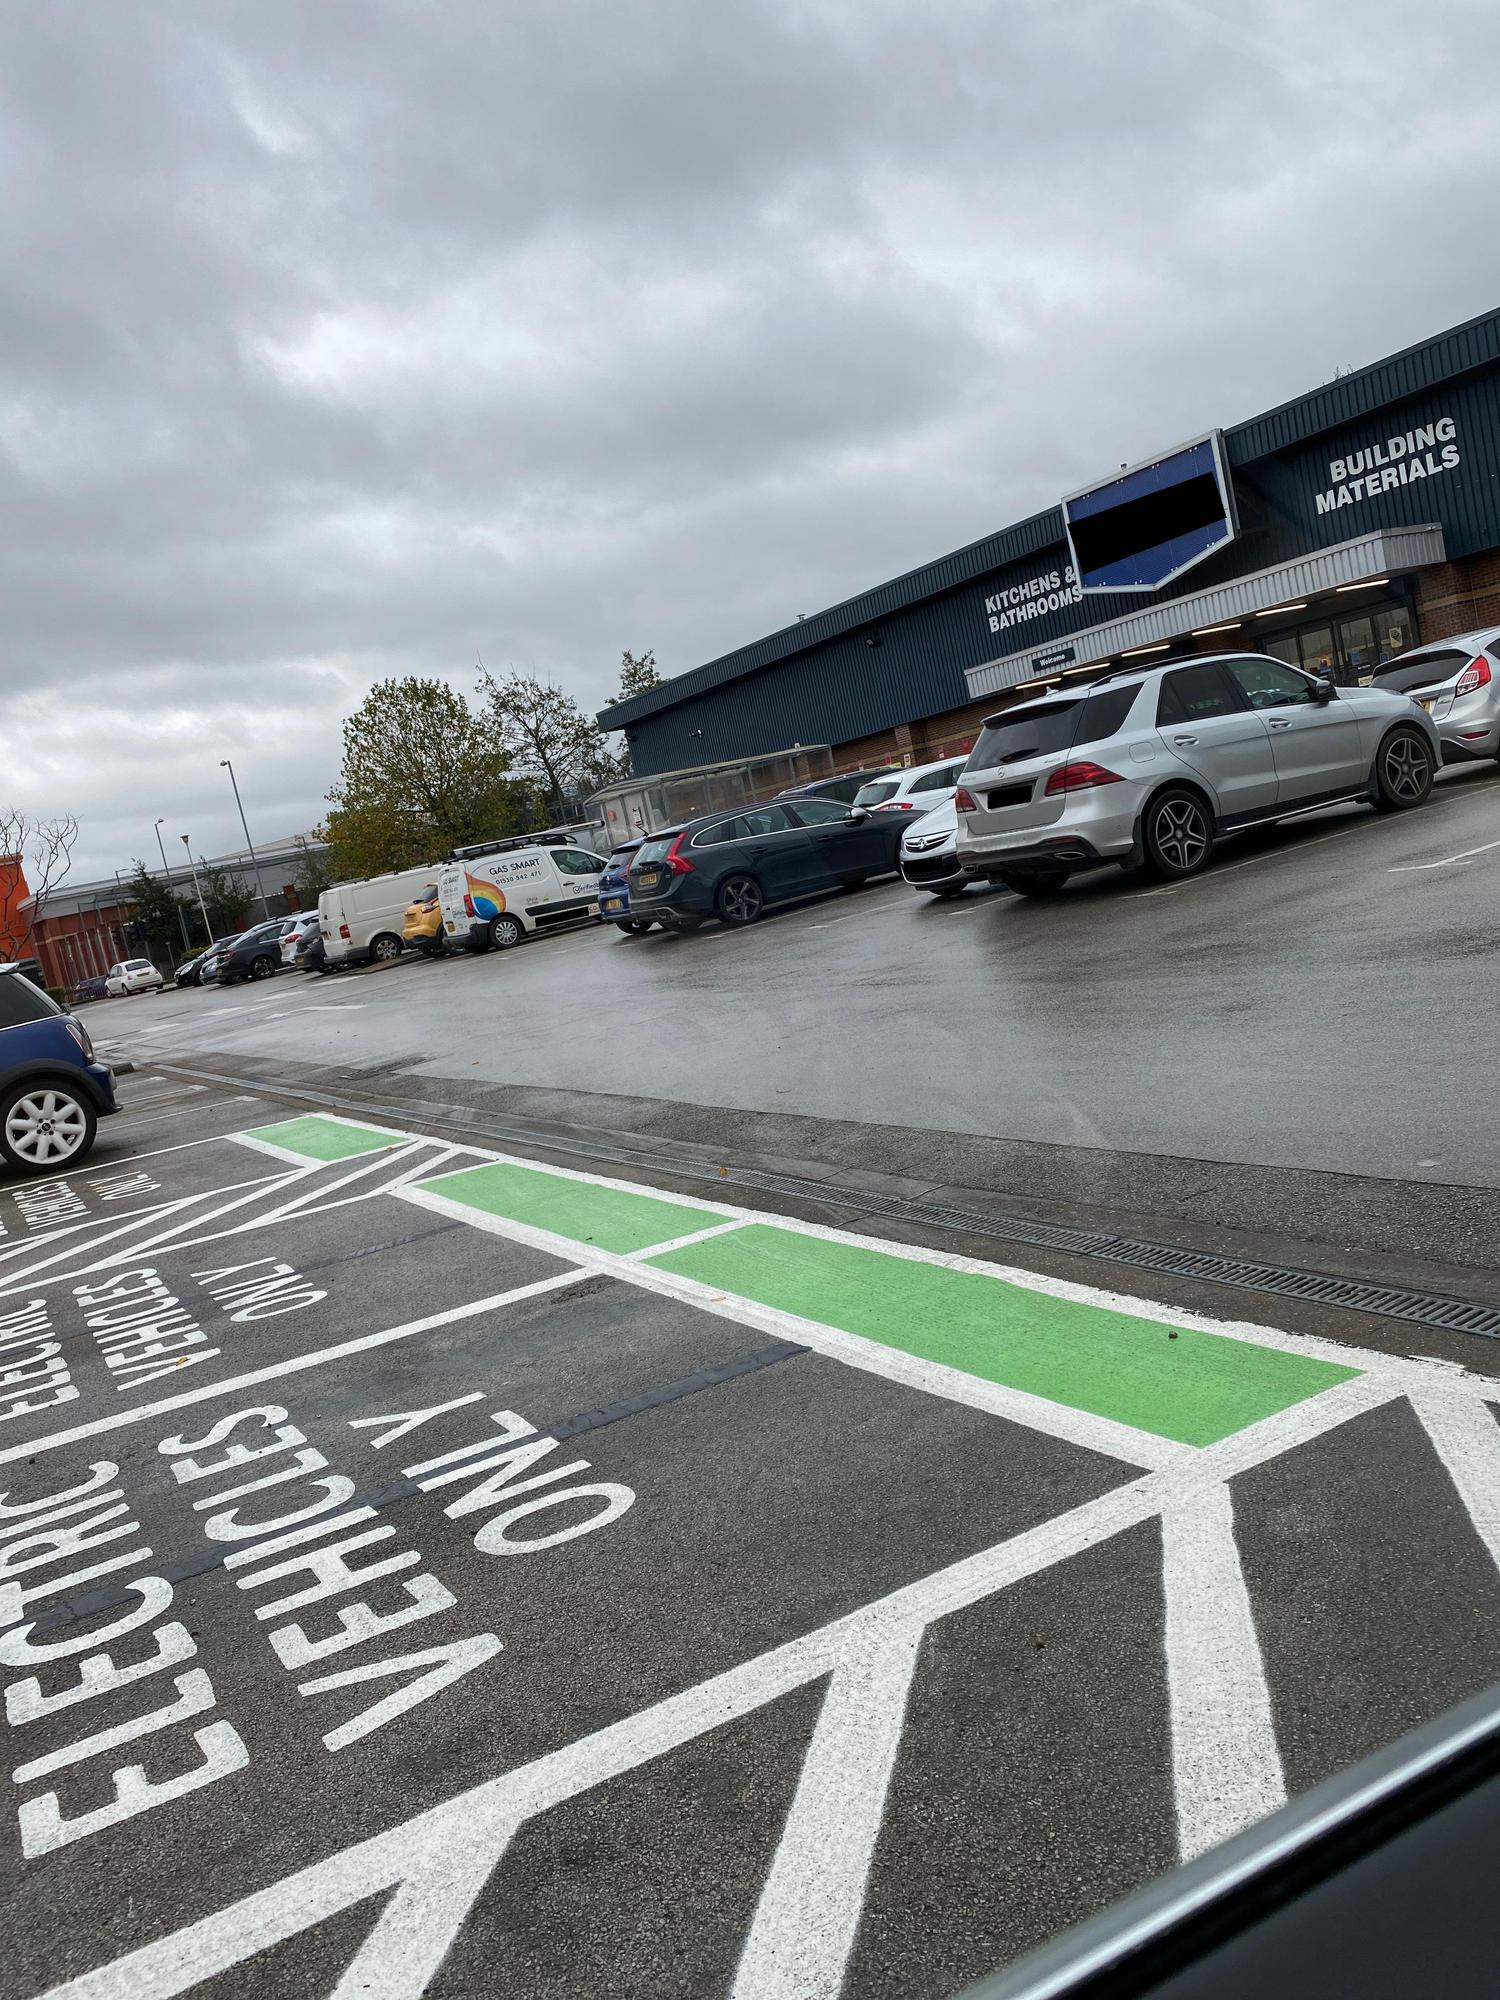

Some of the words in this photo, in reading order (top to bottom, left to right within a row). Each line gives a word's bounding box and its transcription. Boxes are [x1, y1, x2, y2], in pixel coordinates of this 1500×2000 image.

[1314, 443, 1461, 515] MATERIALS
[1329, 416, 1458, 484] BUILDING
[985, 571, 1061, 614] KITCHENS
[1065, 565, 1076, 583] &
[988, 584, 1083, 633] BATHROOMS
[1039, 653, 1066, 667] Welcome
[489, 865, 509, 876] GAS
[511, 858, 540, 871] SMART
[12, 1181, 92, 1230] VEHICLES
[86, 1171, 161, 1200] ONLY
[190, 1256, 328, 1322] ONLY
[72, 1268, 221, 1391] VEHICLES
[348, 1391, 637, 1557] ONLY
[157, 1404, 504, 1752] VEHICLES
[0, 1460, 250, 1860] ELECTRIC
